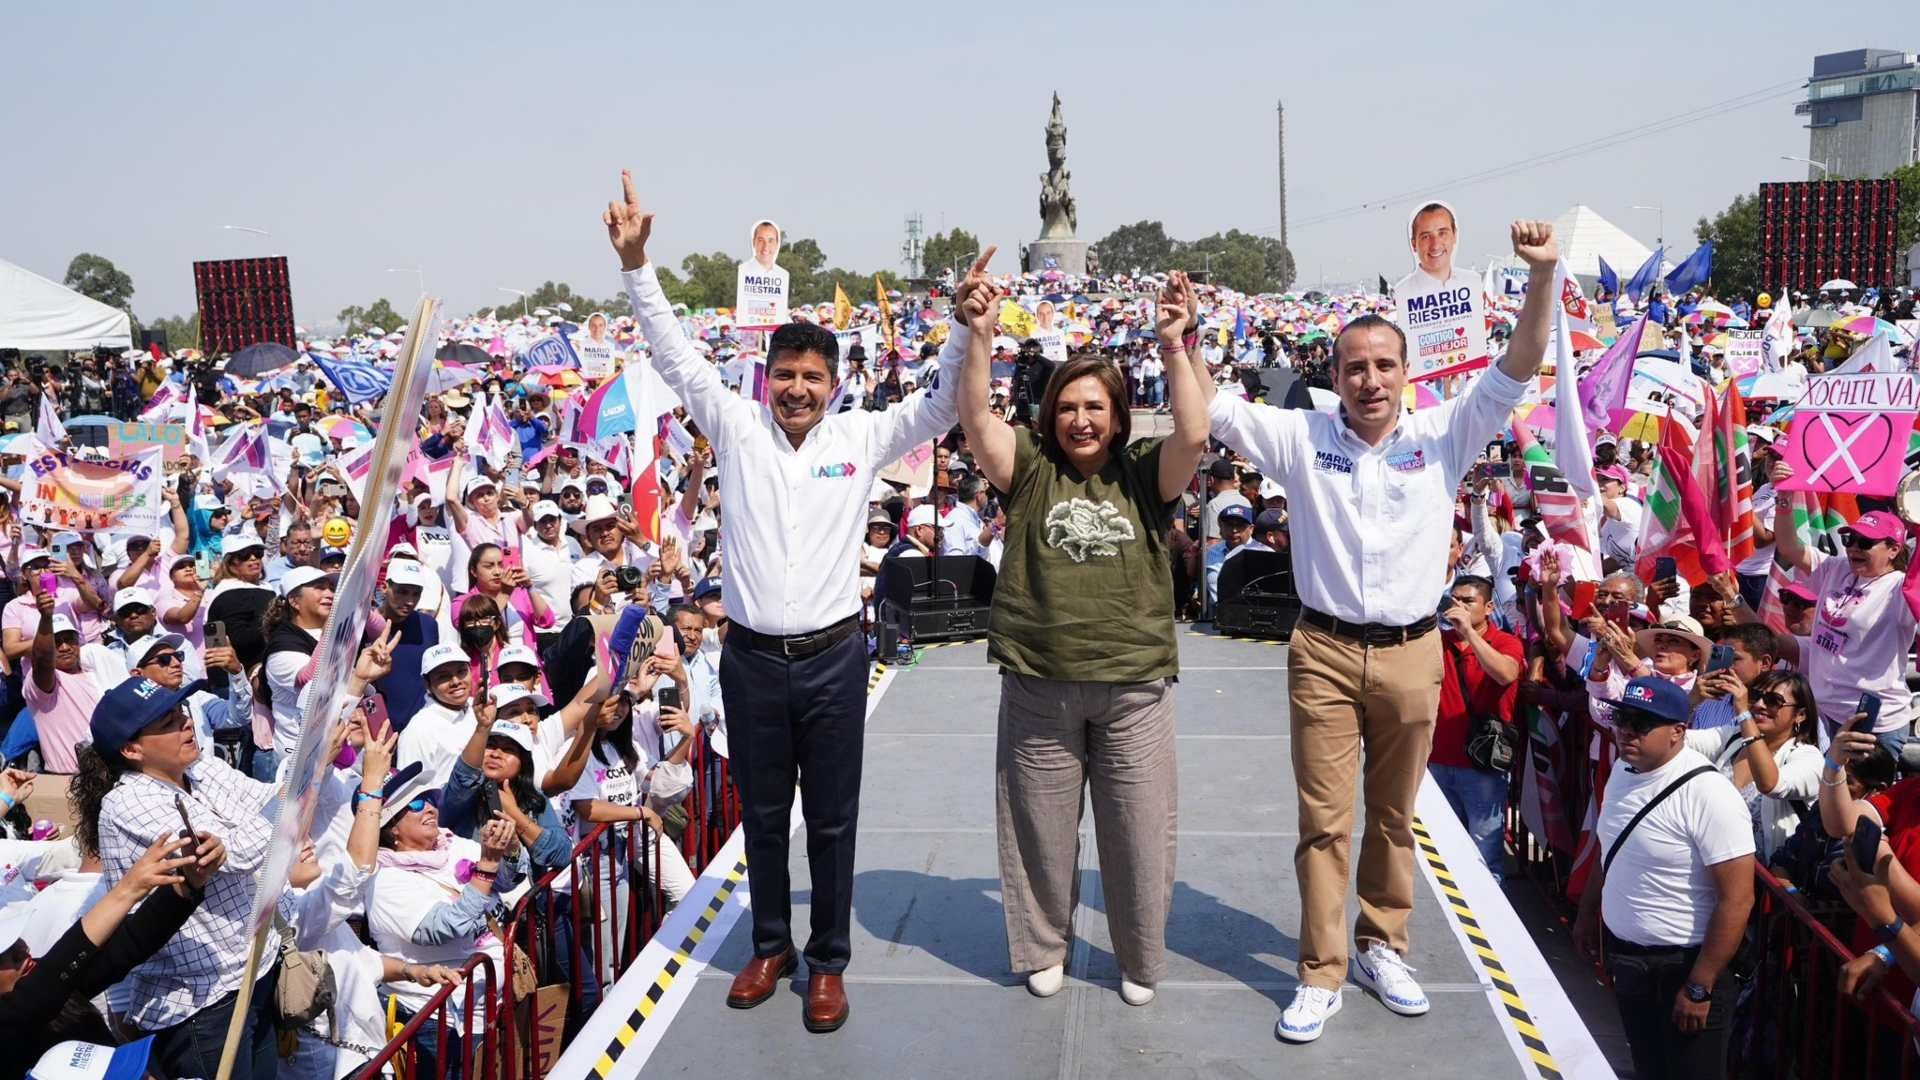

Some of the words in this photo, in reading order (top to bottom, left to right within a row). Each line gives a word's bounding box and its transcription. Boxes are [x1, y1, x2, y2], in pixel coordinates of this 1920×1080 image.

[744, 275, 782, 287] MARIO
[743, 285, 781, 295] RIESTRA
[1407, 286, 1471, 312] MARIO
[1408, 301, 1472, 325] RIESTRA
[1442, 337, 1467, 352] MEJOR
[119, 423, 181, 445] LALO
[1316, 451, 1353, 466] MARIO
[1314, 460, 1351, 474] RIESTRA
